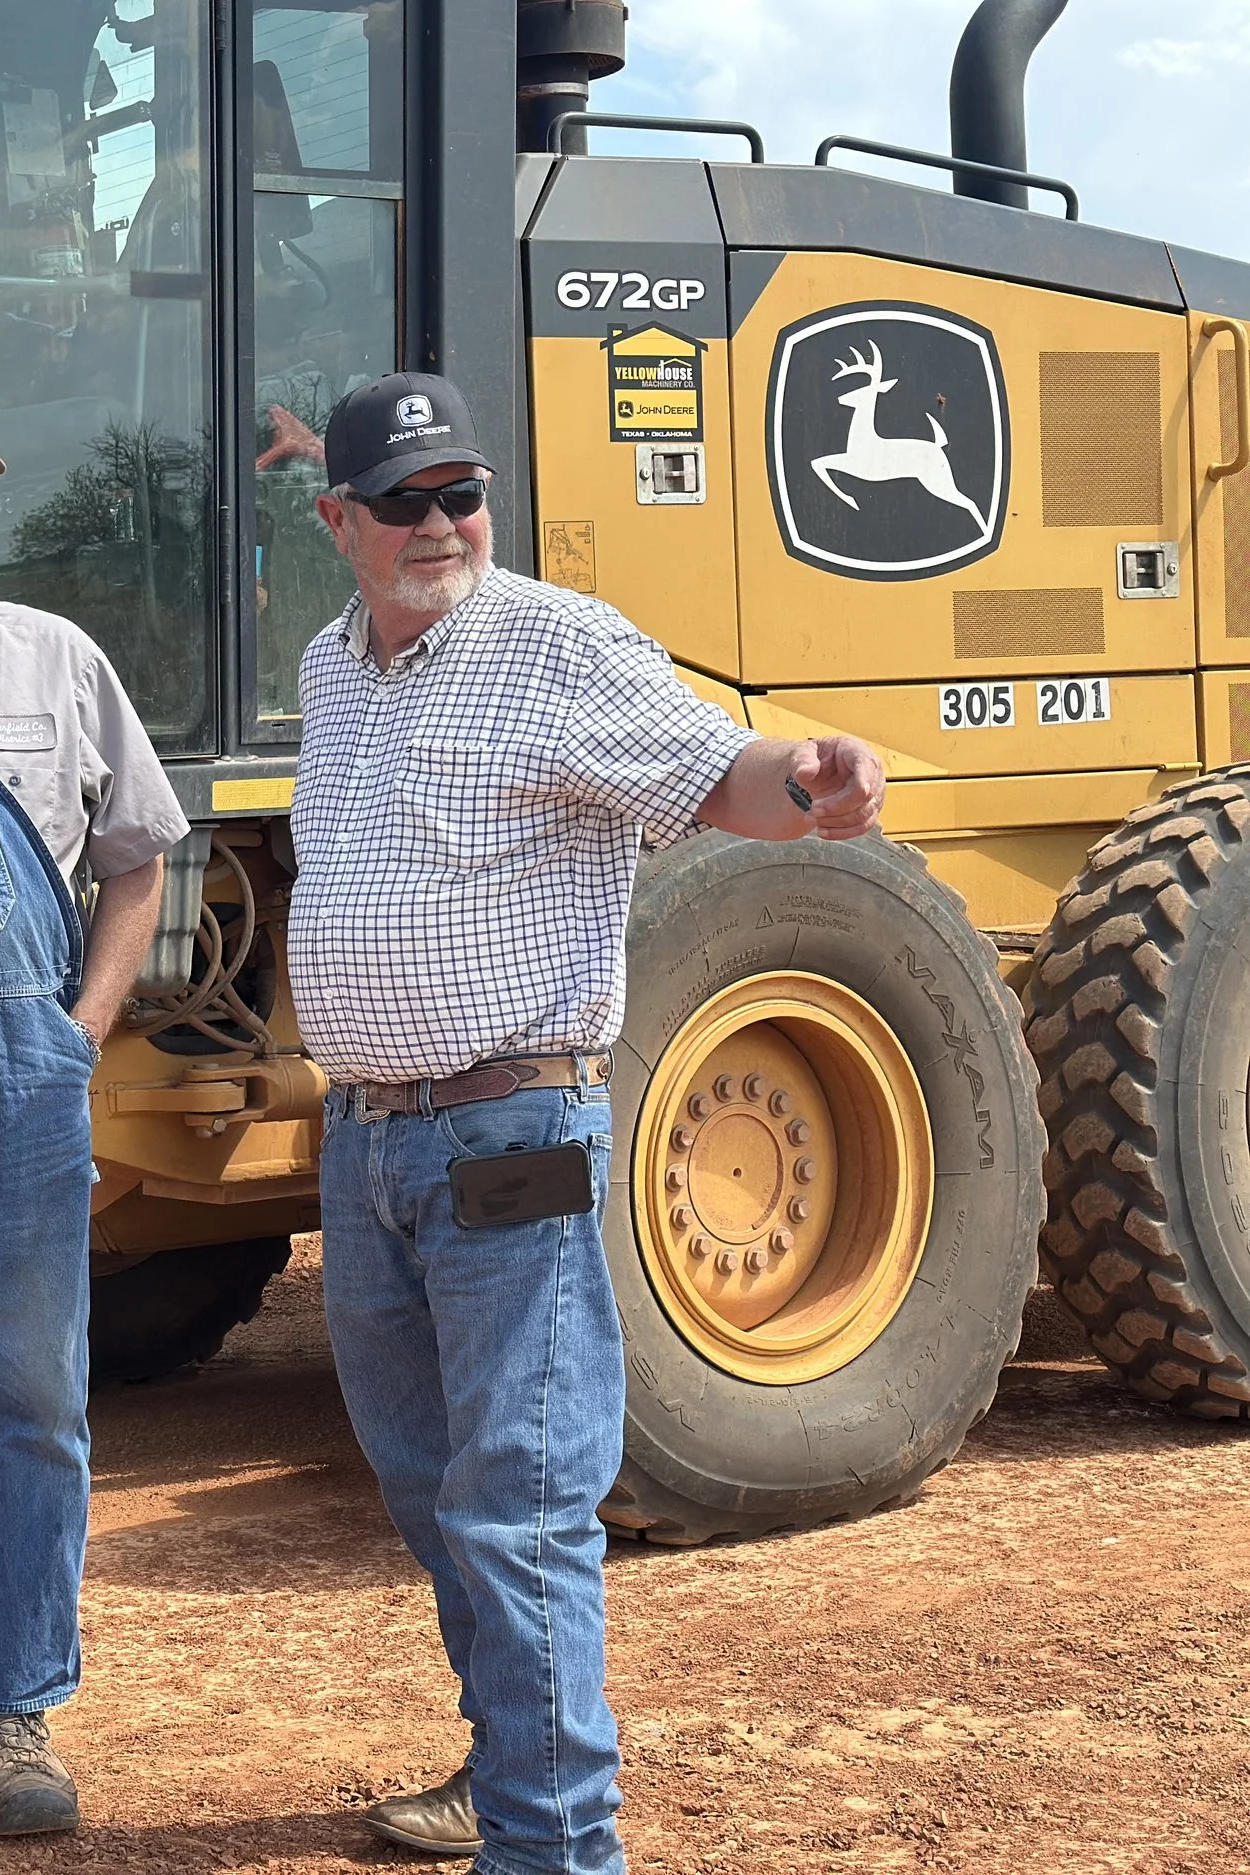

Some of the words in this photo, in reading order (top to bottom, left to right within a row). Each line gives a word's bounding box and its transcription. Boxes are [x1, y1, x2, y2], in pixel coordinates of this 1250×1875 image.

[556, 271, 706, 310] 672GP
[615, 360, 693, 380] YELLOWHOUSE
[641, 380, 682, 388] MACHINERY
[683, 380, 696, 388] CO.
[942, 686, 1012, 727] 305
[1040, 681, 1105, 723] 201
[32, 721, 47, 731] Co.
